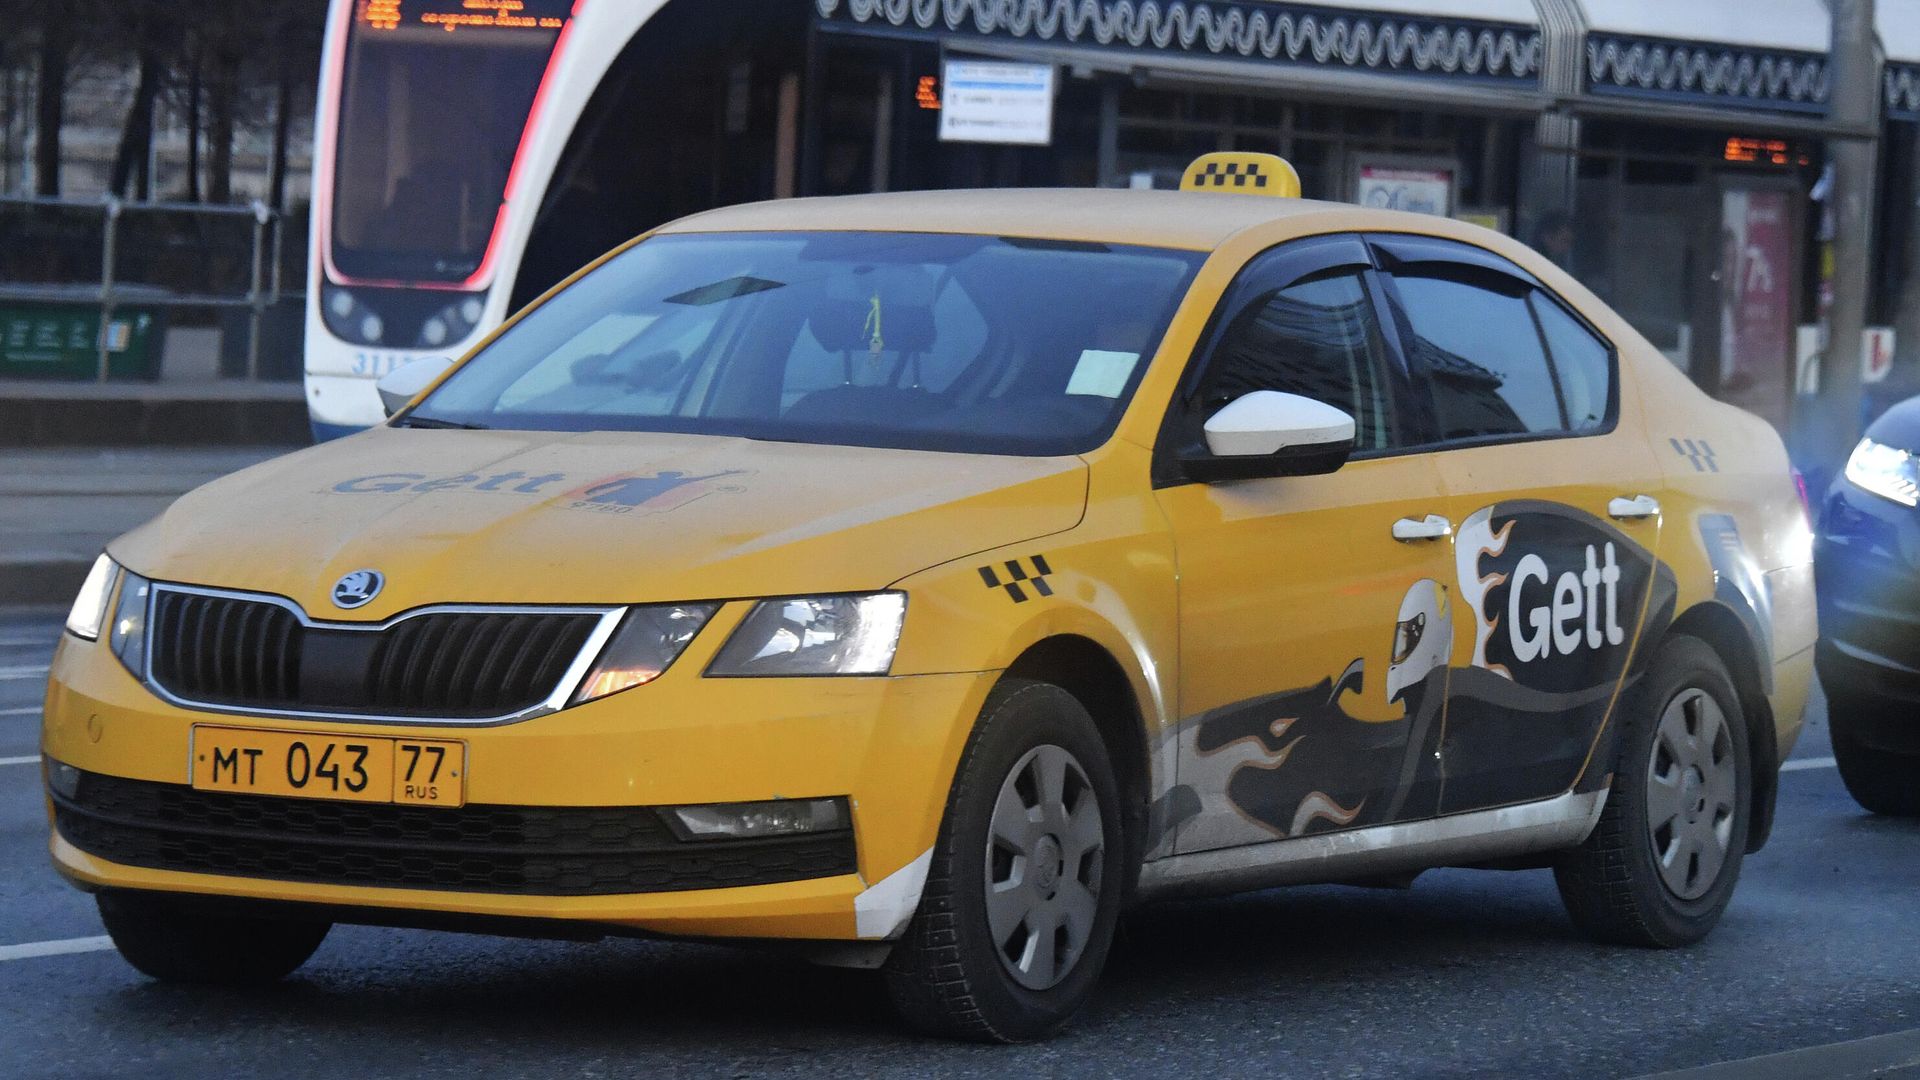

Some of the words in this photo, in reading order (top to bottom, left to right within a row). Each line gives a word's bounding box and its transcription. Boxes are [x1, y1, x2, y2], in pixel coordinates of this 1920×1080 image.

[351, 352, 413, 375] 311
[332, 472, 565, 494] Gett
[1508, 541, 1624, 662] Gett
[286, 742, 369, 792] 043
[401, 745, 445, 782] 77
[405, 785, 438, 799] RUS
